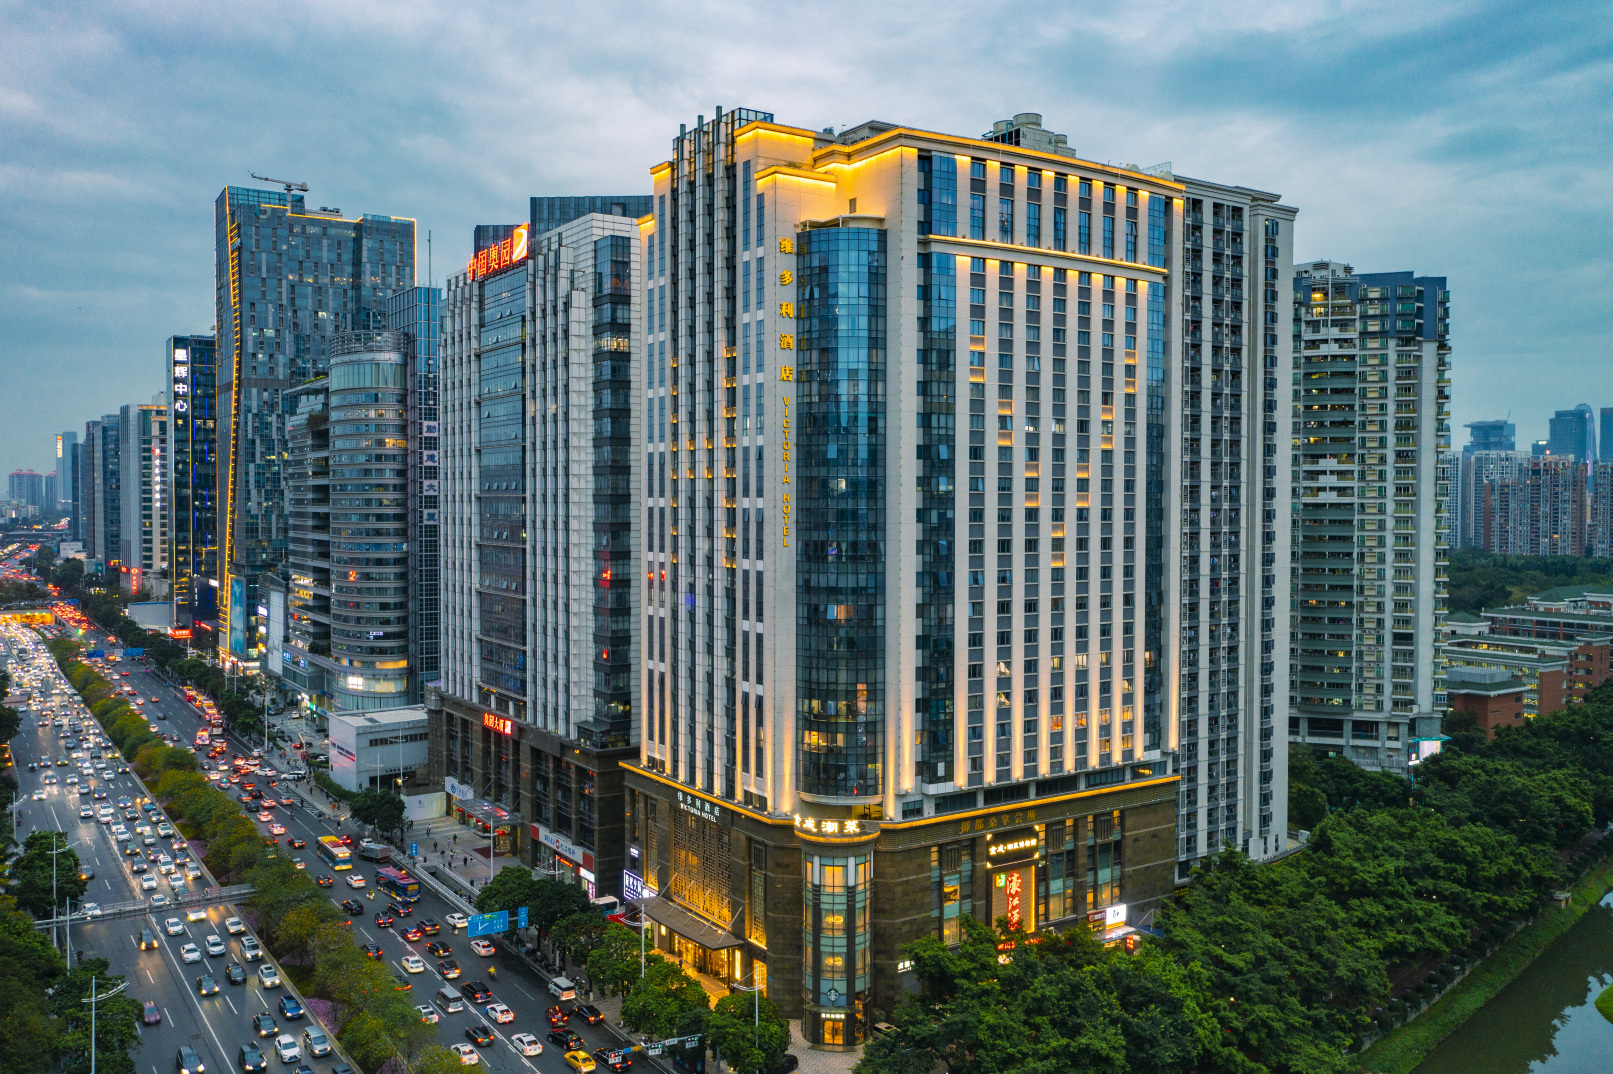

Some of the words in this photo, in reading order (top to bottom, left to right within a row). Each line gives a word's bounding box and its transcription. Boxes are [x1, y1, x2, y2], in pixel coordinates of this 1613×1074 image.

[467, 238, 511, 280] 中国奥园
[779, 237, 794, 382] 维多利酒店
[174, 348, 188, 411] 星辉中心
[782, 396, 791, 484] VICTORIA
[782, 493, 791, 547] HOTEL
[678, 791, 720, 816] 维多利酒店
[680, 802, 700, 816] VICTORIA
[702, 811, 717, 823] HOTEL
